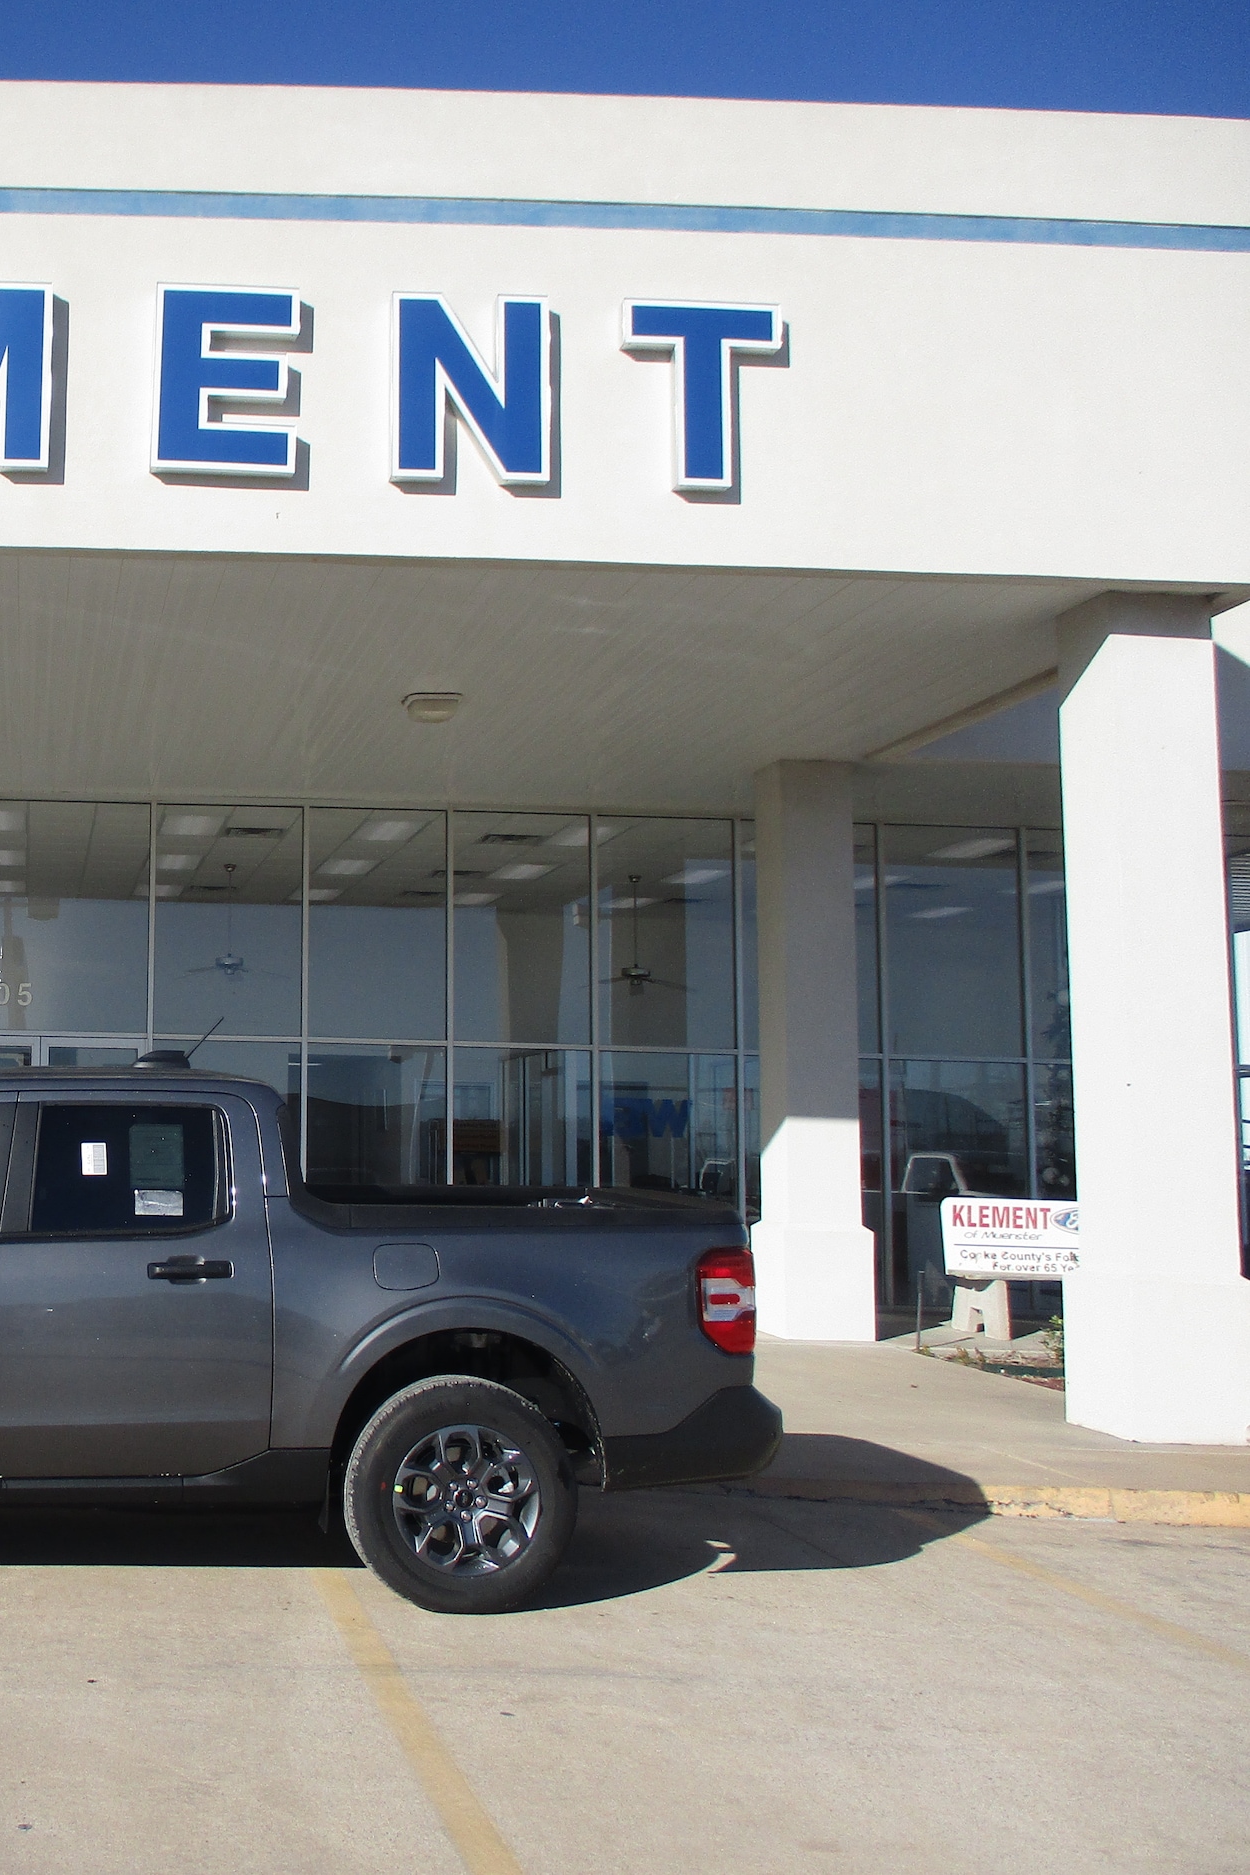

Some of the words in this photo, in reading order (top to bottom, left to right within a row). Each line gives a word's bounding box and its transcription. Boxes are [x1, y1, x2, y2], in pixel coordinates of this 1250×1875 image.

[952, 1204, 1051, 1230] KLEMENT
[963, 1231, 979, 1240] of
[981, 1231, 1043, 1241] Muenster
[1001, 1251, 1051, 1263] County's
[1015, 1264, 1040, 1272] over
[1044, 1263, 1058, 1272] 65
